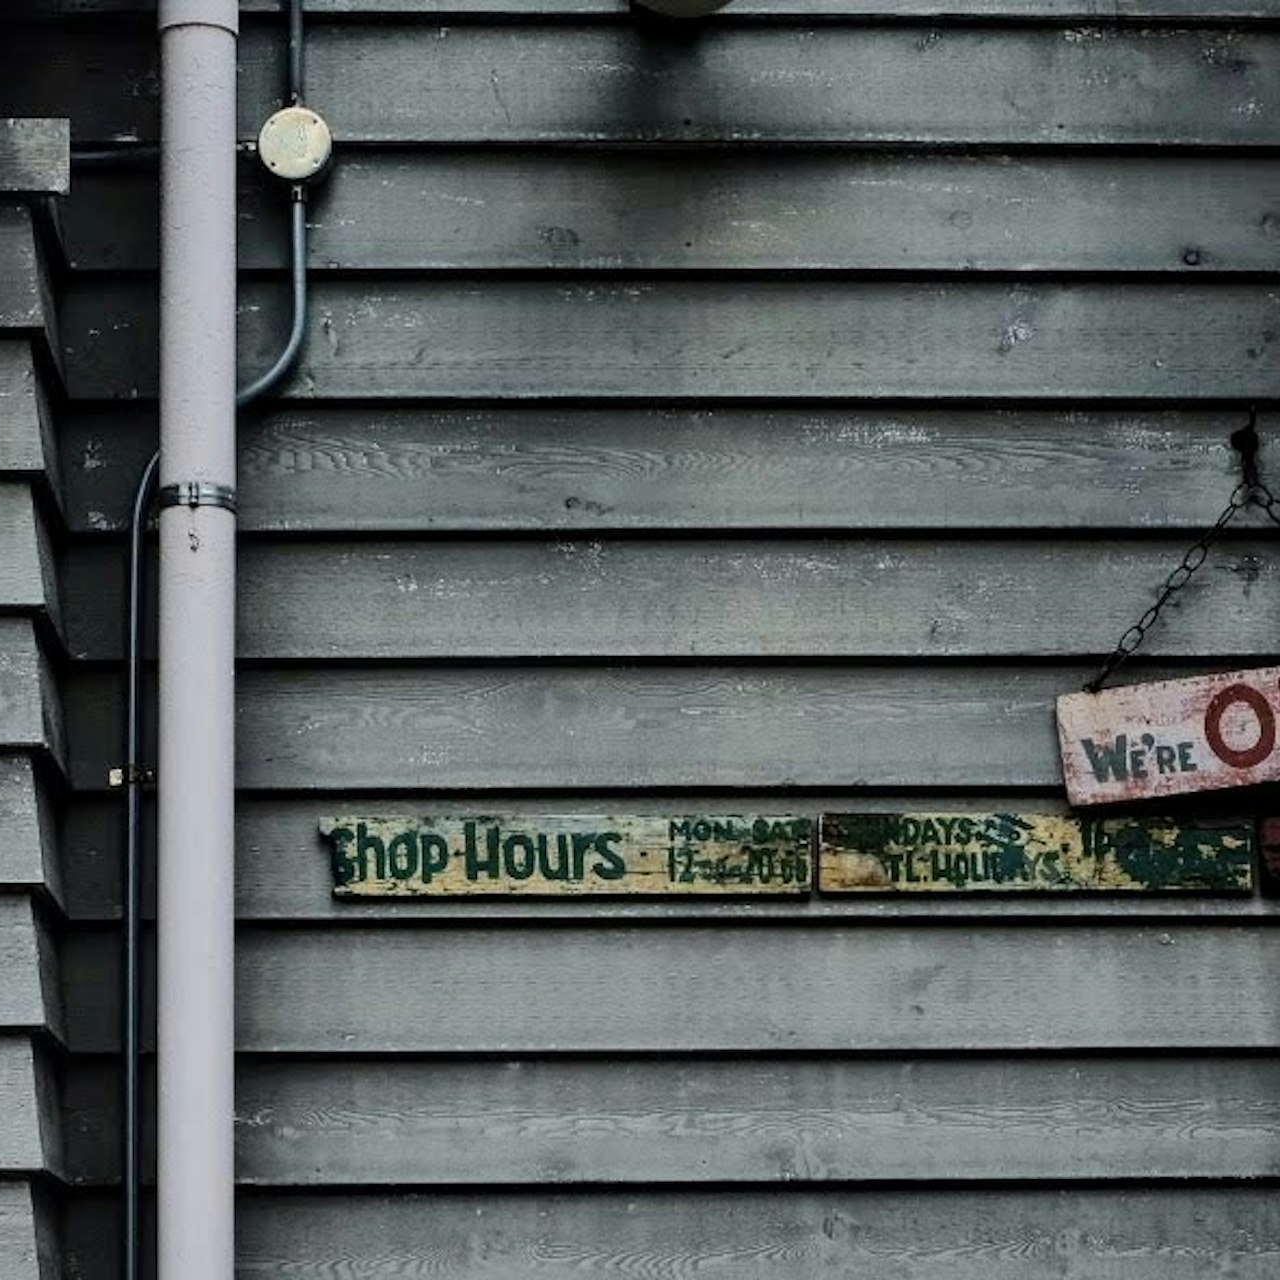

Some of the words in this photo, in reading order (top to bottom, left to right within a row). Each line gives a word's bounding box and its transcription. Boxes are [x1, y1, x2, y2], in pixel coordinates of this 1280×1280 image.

[1081, 732, 1198, 783] WE'RE
[329, 822, 449, 884] Shop
[464, 821, 626, 881] Hours
